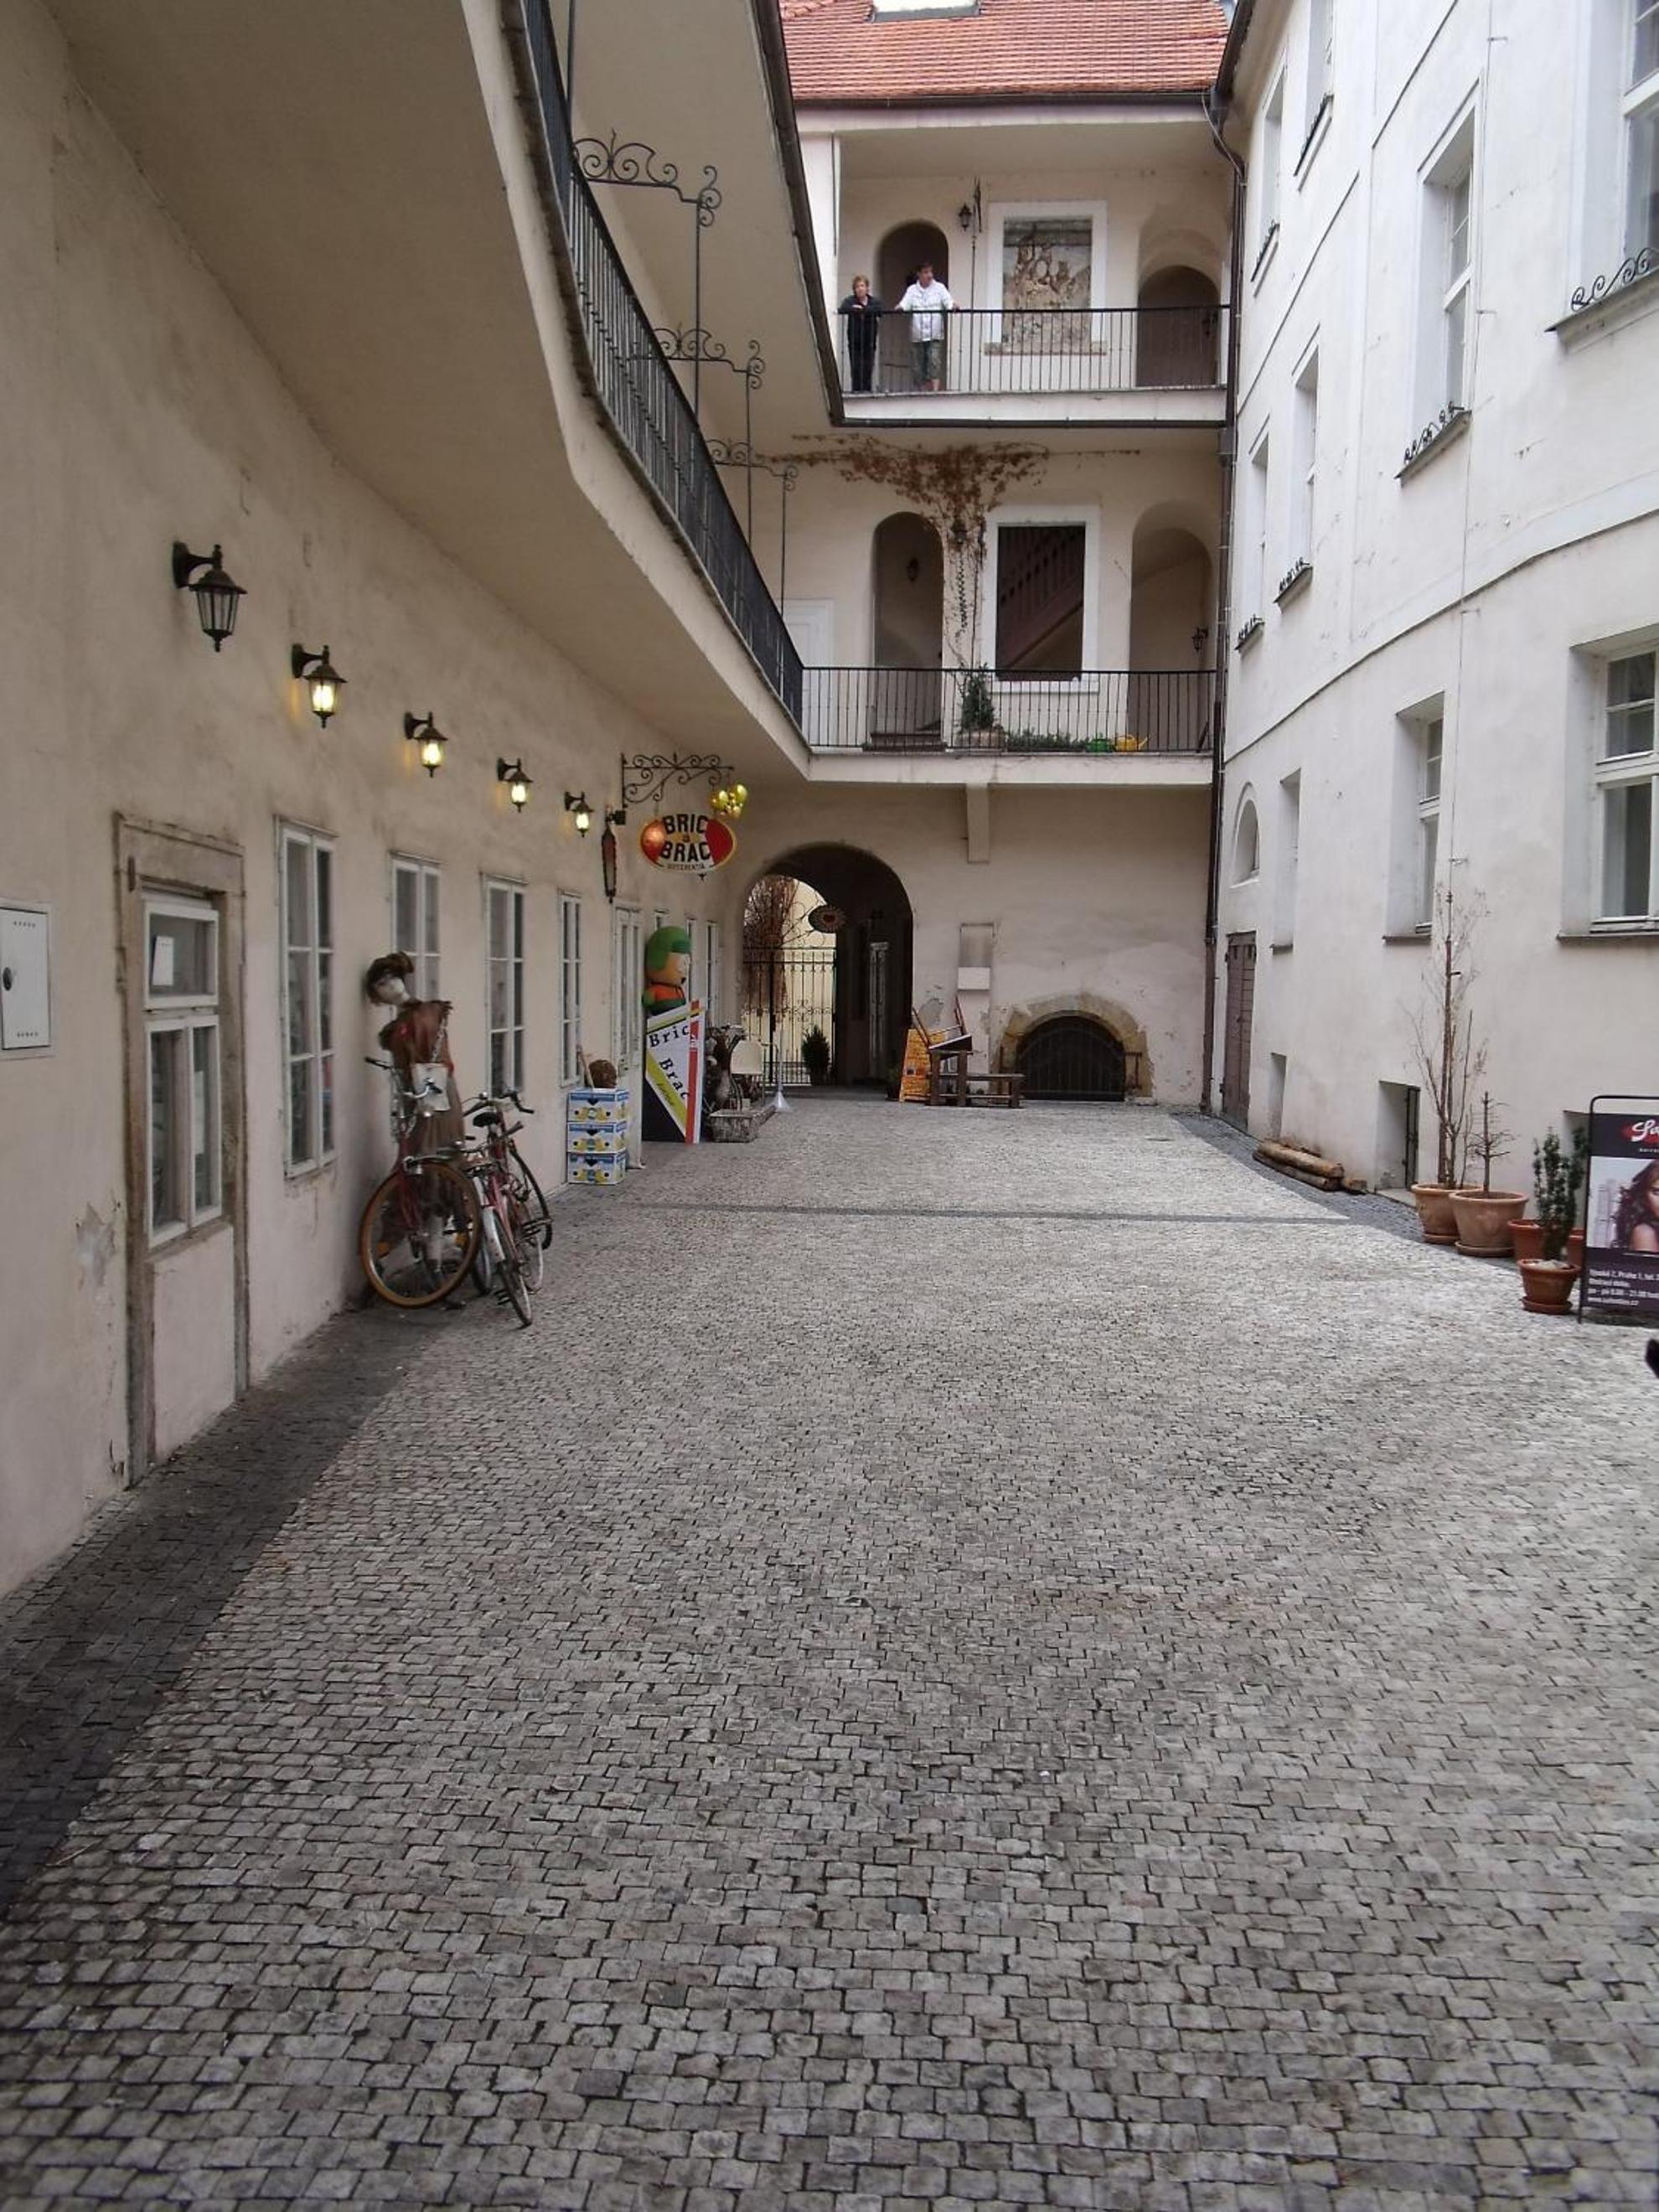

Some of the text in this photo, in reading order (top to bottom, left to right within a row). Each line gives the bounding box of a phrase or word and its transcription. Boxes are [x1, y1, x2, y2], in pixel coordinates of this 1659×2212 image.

[663, 814, 709, 834] BRIC
[660, 840, 711, 862] BRAC
[649, 1024, 690, 1048] Bric
[659, 1057, 690, 1099] Brac
